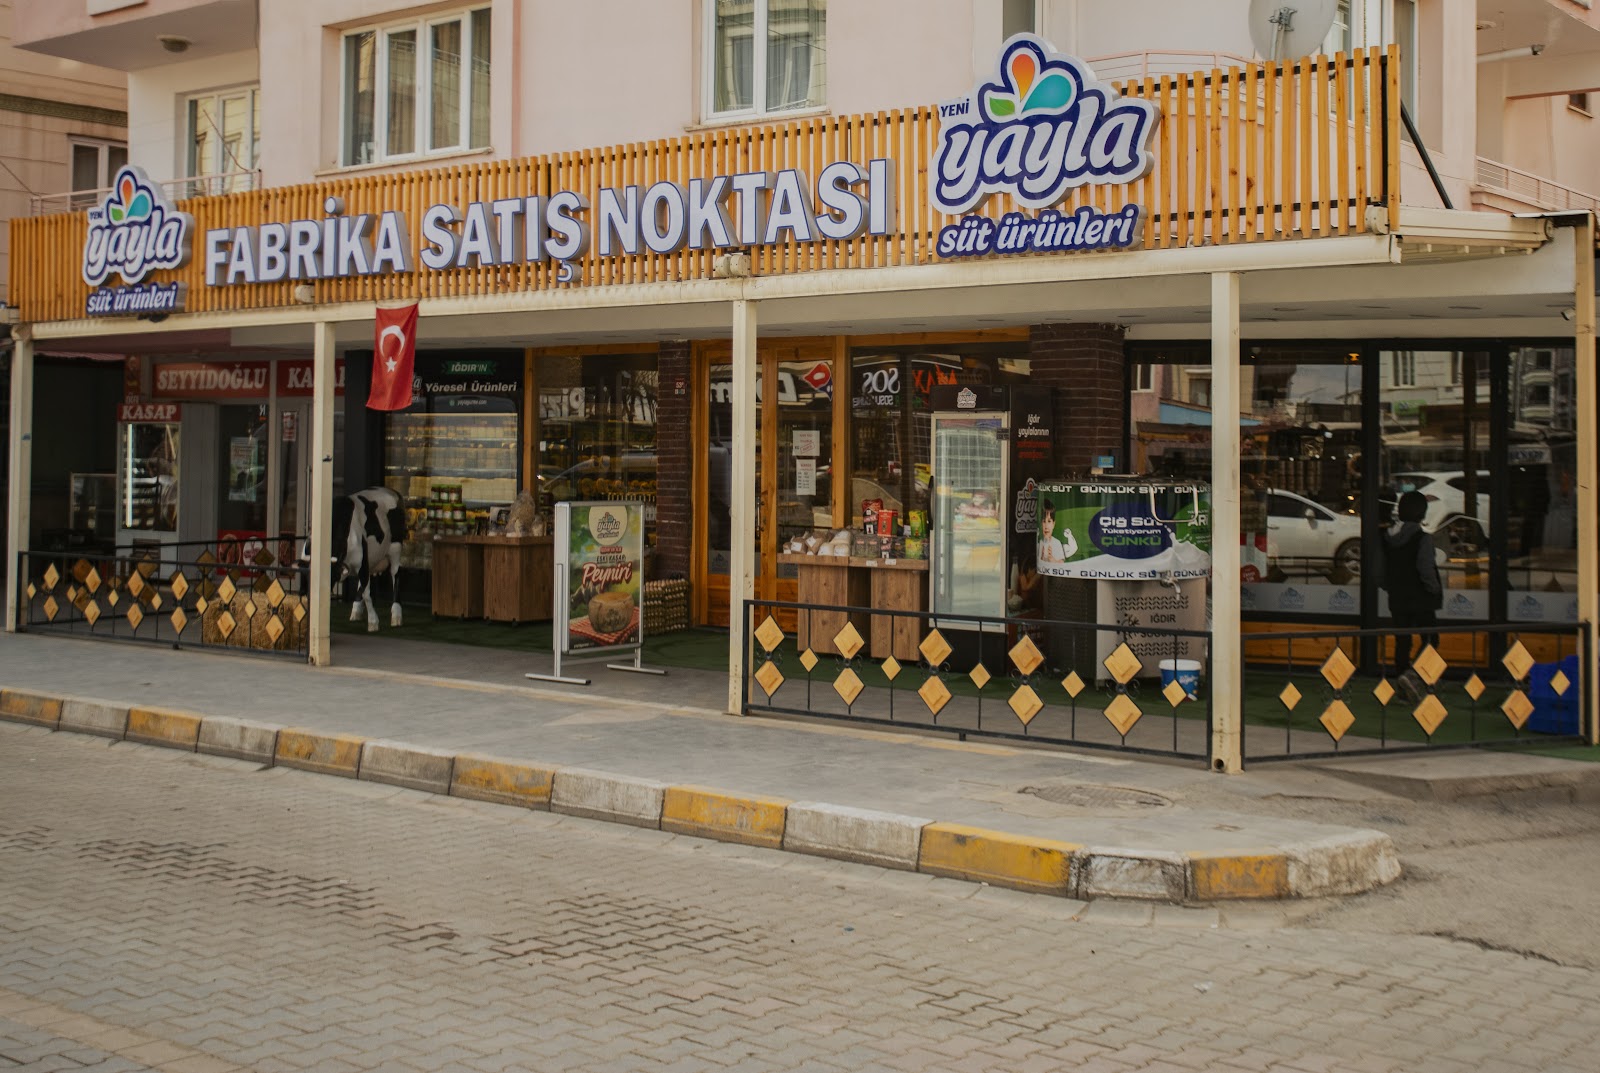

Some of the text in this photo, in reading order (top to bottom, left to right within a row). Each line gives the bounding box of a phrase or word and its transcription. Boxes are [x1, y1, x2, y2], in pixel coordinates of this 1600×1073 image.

[941, 98, 970, 118] YENİ
[940, 96, 1139, 199] yayla
[206, 158, 892, 287] FABRİKA SATIŞ NOKTASI
[940, 208, 1134, 253] süt ürünleri
[86, 211, 182, 280] yayla
[87, 284, 177, 312] süt ürünleri
[157, 364, 267, 390] SEYYİDOĞLU
[425, 381, 467, 393] Yöresel
[471, 379, 517, 392] Ürünleri
[122, 404, 178, 420] KASAP
[1080, 485, 1136, 494] GÜNLÜK
[1101, 528, 1162, 536] Tüketiyorum
[1101, 535, 1162, 546] ÇÜNKÜ
[583, 562, 631, 588] Peyniri
[1052, 568, 1071, 576] SÜT
[1080, 570, 1134, 578] GÜNLÜK
[1150, 613, 1177, 623] IĞDIR
